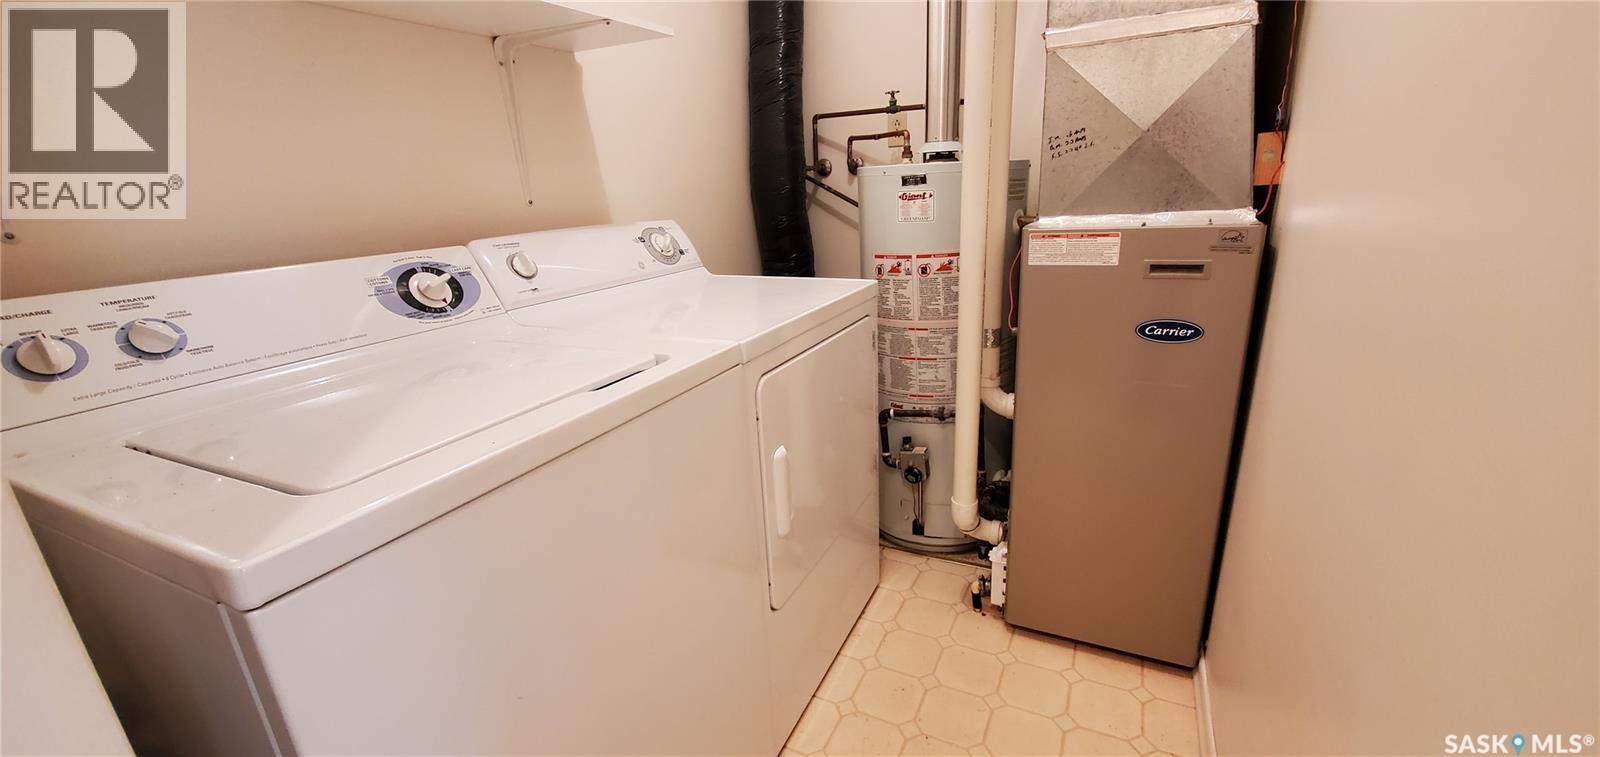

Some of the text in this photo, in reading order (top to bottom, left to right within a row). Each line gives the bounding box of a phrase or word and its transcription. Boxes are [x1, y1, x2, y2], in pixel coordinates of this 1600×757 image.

[901, 191, 928, 202] Giant
[100, 294, 156, 308] TEMPERATURE
[1144, 325, 1195, 337] Carrier
